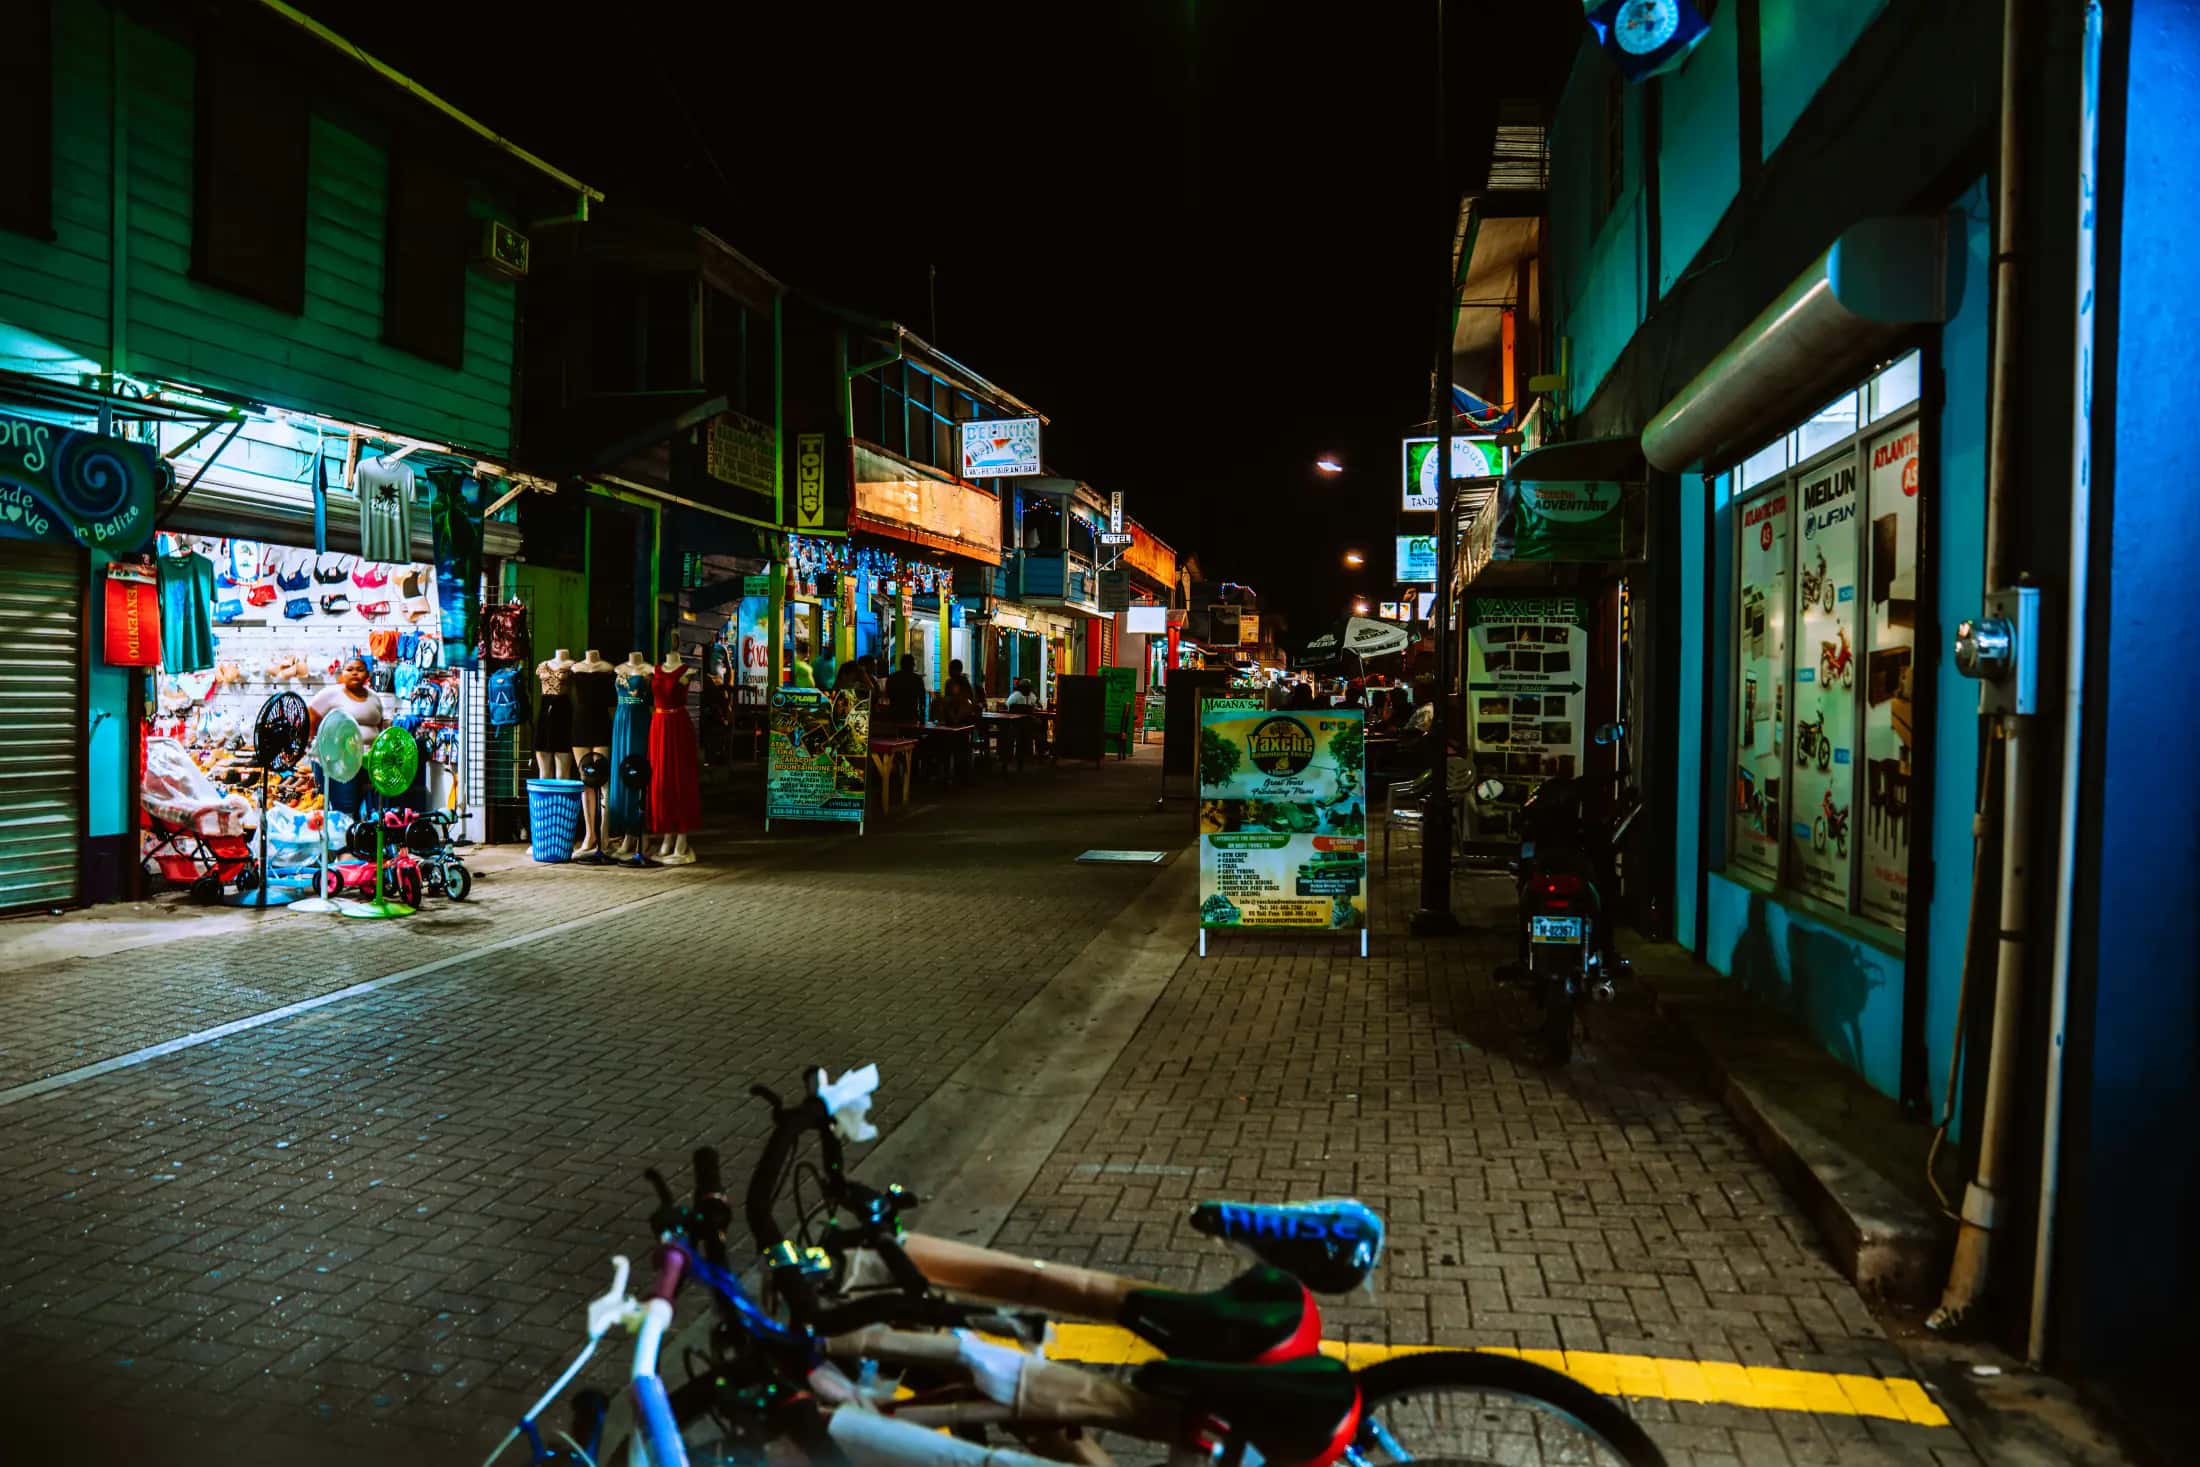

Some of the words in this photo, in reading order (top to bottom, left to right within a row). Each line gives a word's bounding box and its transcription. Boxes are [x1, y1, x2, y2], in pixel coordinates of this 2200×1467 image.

[966, 422, 1036, 440] BELIKIN
[800, 439, 821, 512] TOURS
[1804, 466, 1856, 512] MEILUN
[1535, 499, 1608, 511] ADVENTURE
[73, 525, 89, 539] in
[94, 505, 140, 541] Belize
[1477, 599, 1576, 615] YAXCHE
[1247, 734, 1313, 753] Yaxche
